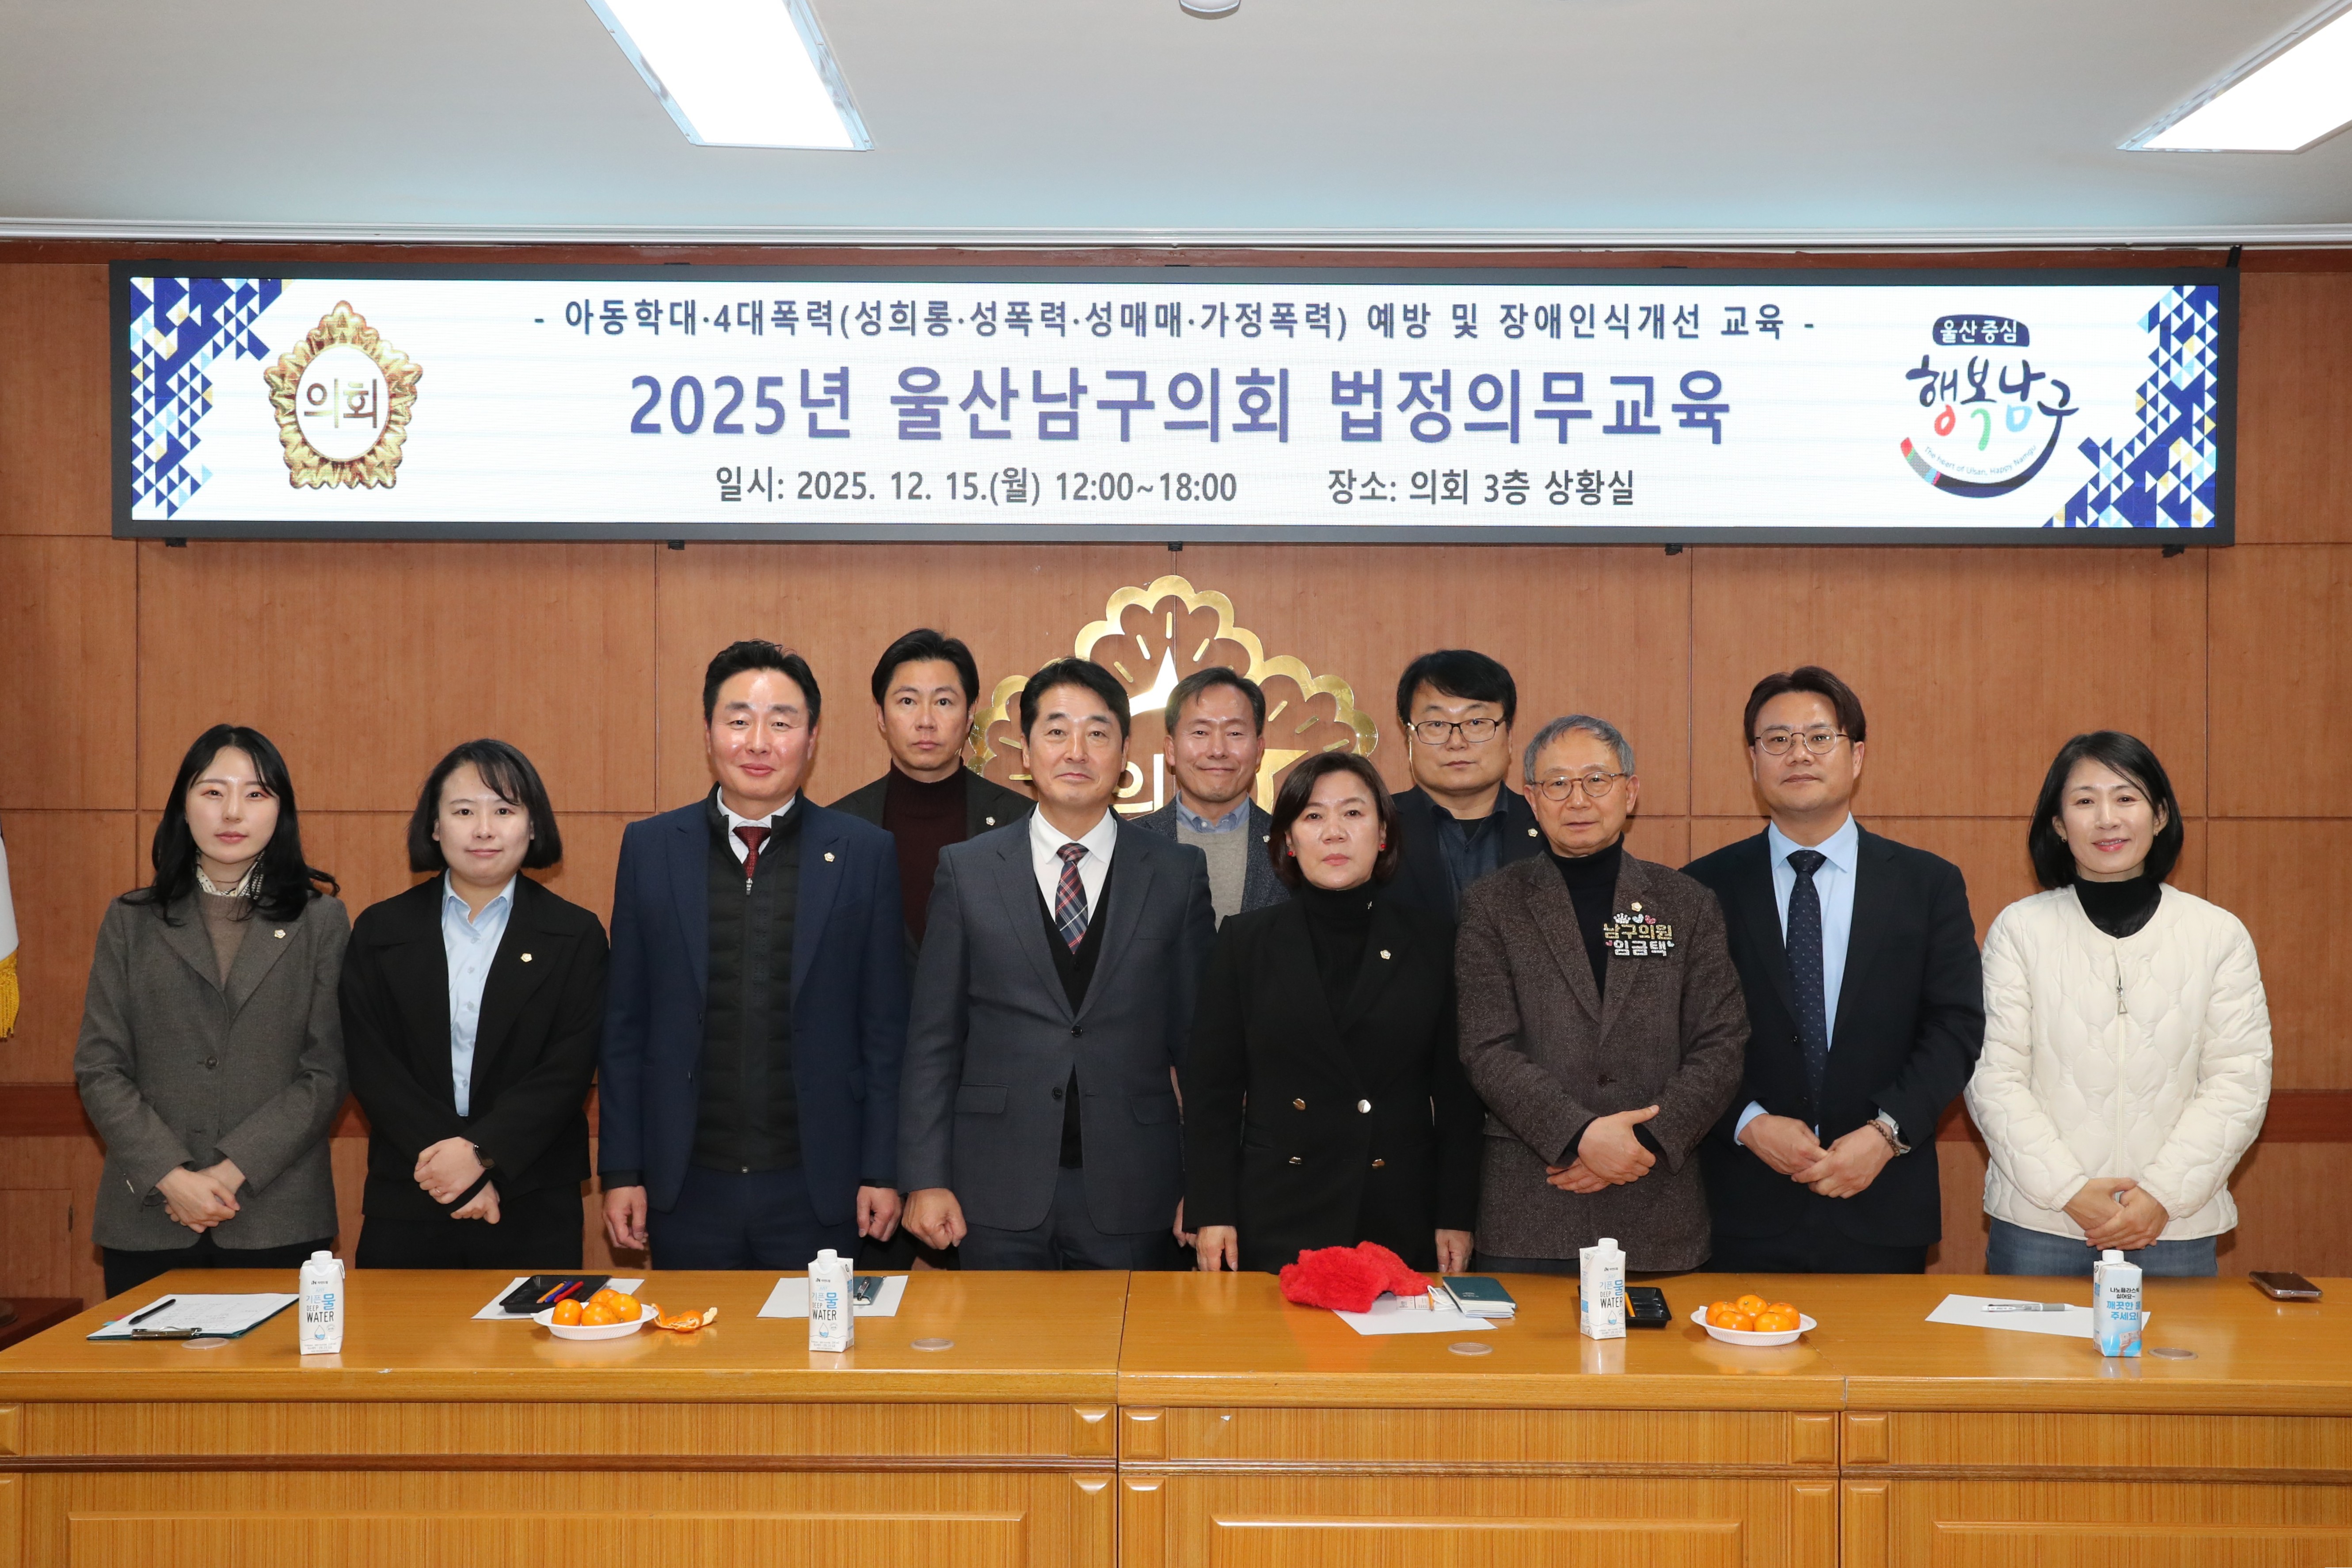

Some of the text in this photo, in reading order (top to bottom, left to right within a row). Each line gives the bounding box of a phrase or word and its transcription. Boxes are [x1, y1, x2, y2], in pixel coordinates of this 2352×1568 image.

[1367, 303, 1431, 338] 예방
[1452, 303, 1478, 339] 및
[1499, 303, 1699, 340] 장애인식개선
[1720, 304, 1784, 340] 교육
[1940, 320, 2018, 343] 울산 중심
[304, 378, 377, 429] 의회
[630, 366, 1730, 445] 2025년 울산남구의회 법정의무교육
[1906, 354, 2079, 451] 행복남구
[1925, 446, 1936, 459] The
[1937, 456, 1955, 470] heart
[1990, 464, 2013, 475] Happy
[2013, 445, 2036, 466] Namgu
[716, 467, 1237, 506] 일시: 2025. 12. 15.(월) 12:00~18:00
[1328, 469, 1633, 506] 장소: 의회 3층 상황실
[1603, 923, 1673, 940] 남구의원
[1613, 940, 1667, 957] 임금택
[1600, 1297, 1623, 1309] WATER
[2107, 1301, 2141, 1310] 깨끗한 물
[307, 1311, 334, 1323] WATER
[812, 1310, 837, 1321] WATER
[2111, 1312, 2139, 1320] 주세요!
